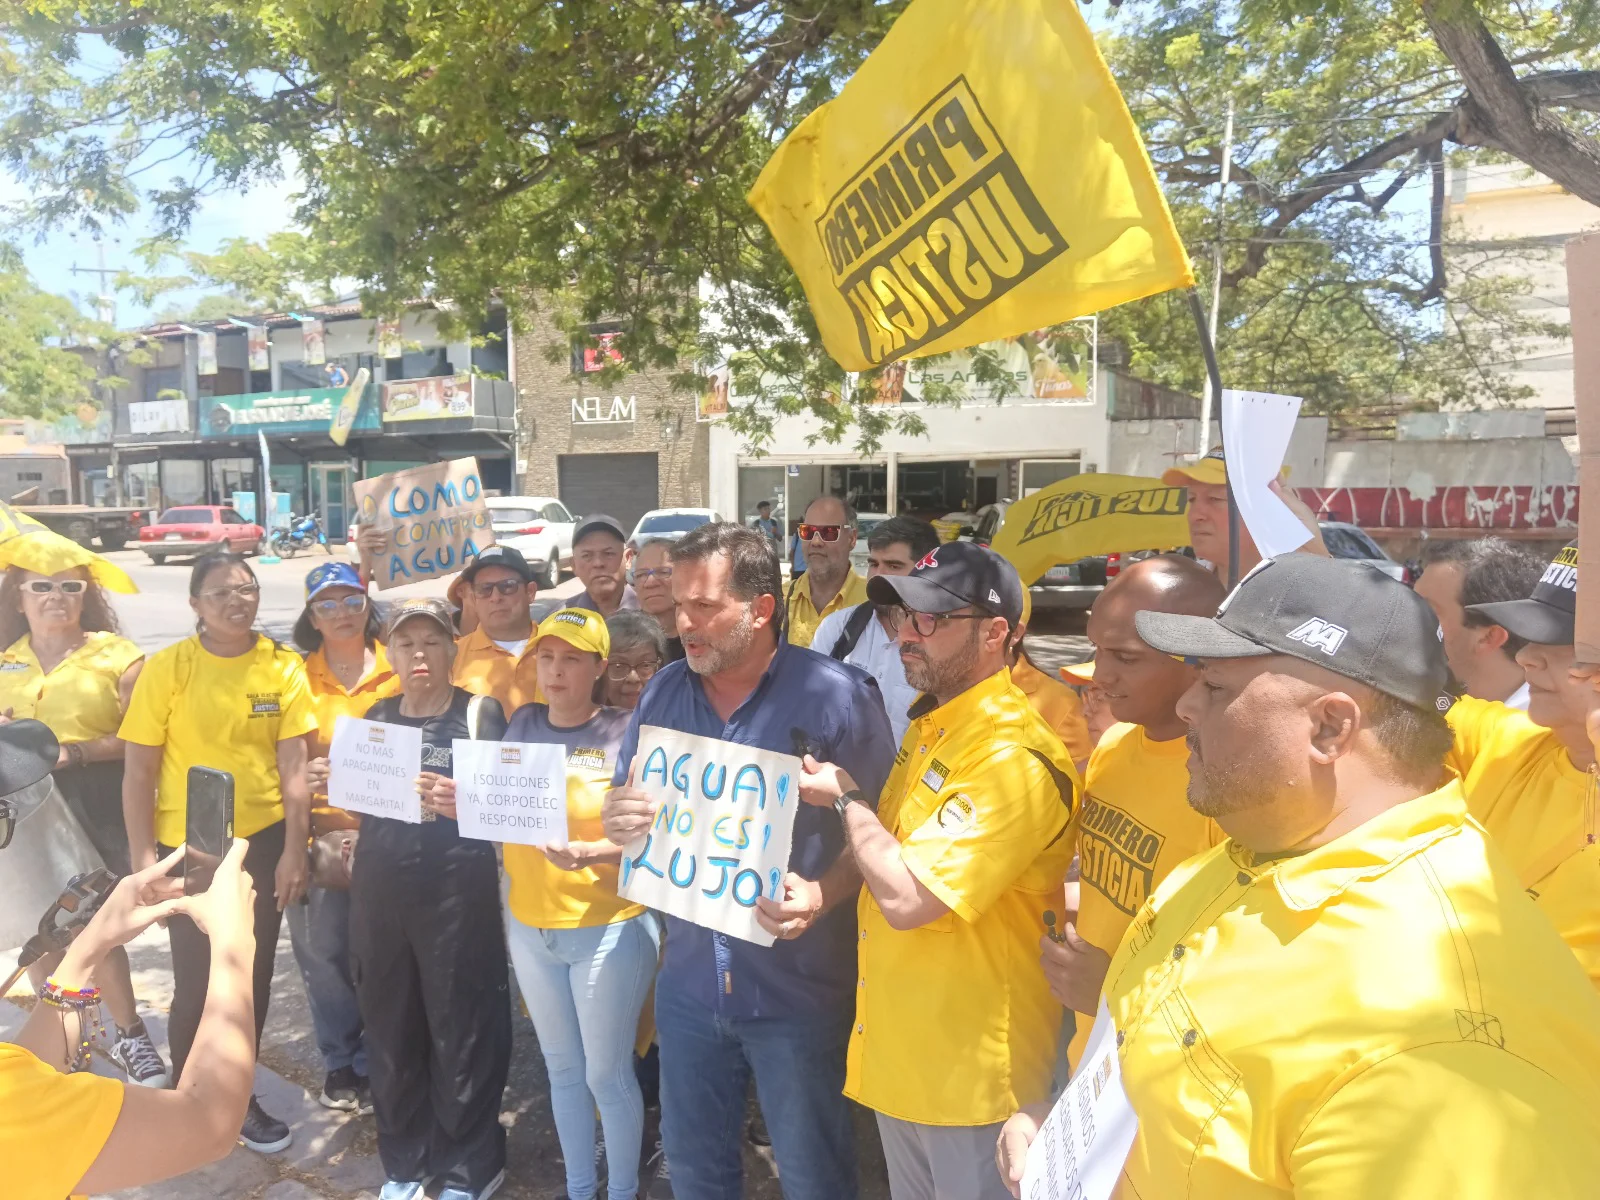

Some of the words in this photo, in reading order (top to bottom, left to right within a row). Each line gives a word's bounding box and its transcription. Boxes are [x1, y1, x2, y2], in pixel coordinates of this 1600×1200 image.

[948, 370, 1028, 385] Aras
[572, 395, 636, 421] NELAM
[389, 474, 482, 518] COMO
[389, 537, 480, 581] AGUA
[356, 742, 370, 754] NO
[372, 745, 394, 759] MAS
[342, 758, 406, 778] APAGANONES
[641, 746, 767, 811] AGUA
[367, 779, 380, 791] EN
[466, 792, 483, 806] YA,
[486, 793, 558, 810] CORPOELEC
[479, 812, 548, 829] RESPONDE!
[653, 803, 695, 837] NO
[712, 812, 752, 850] ES
[631, 834, 764, 908] LUJO
[1080, 832, 1145, 912] STICIA
